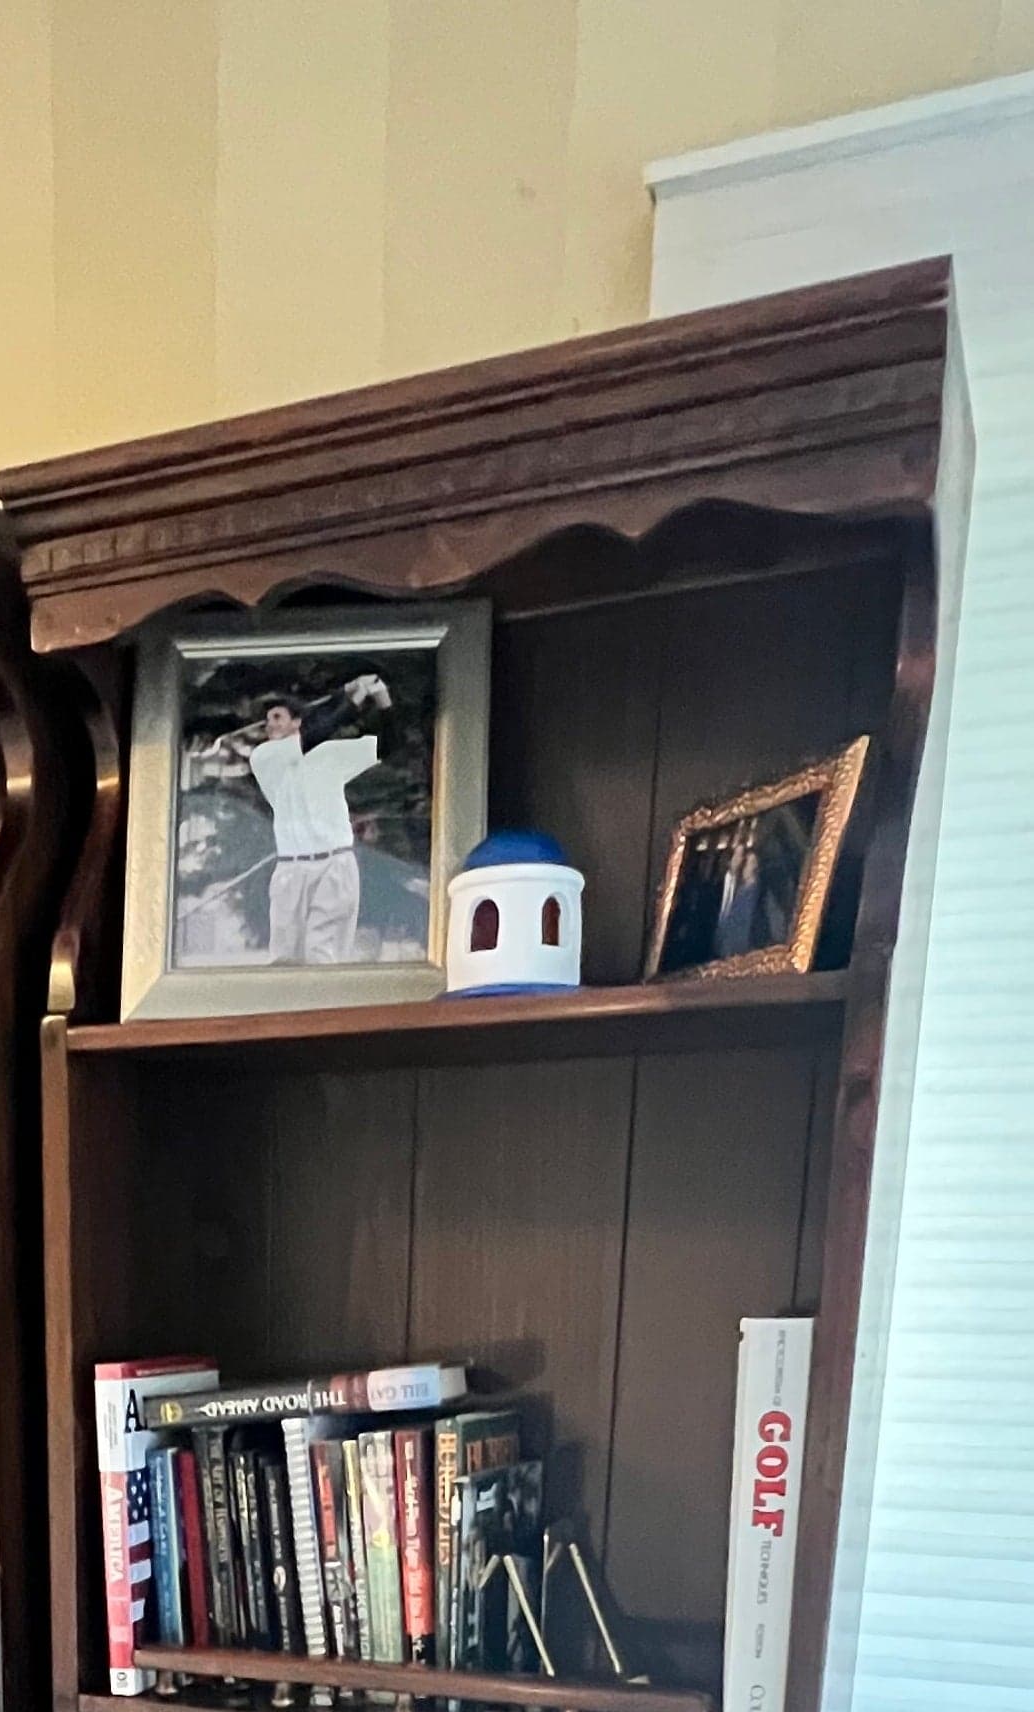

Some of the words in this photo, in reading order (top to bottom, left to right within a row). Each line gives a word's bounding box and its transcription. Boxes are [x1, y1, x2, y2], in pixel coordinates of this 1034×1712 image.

[198, 1397, 259, 1417] AHEAD
[261, 1393, 308, 1412] ROAD
[315, 1389, 347, 1408] THE
[752, 1409, 792, 1538] GOLF
[104, 1484, 126, 1583] AMERICA
[355, 1578, 368, 1619] LIKE
